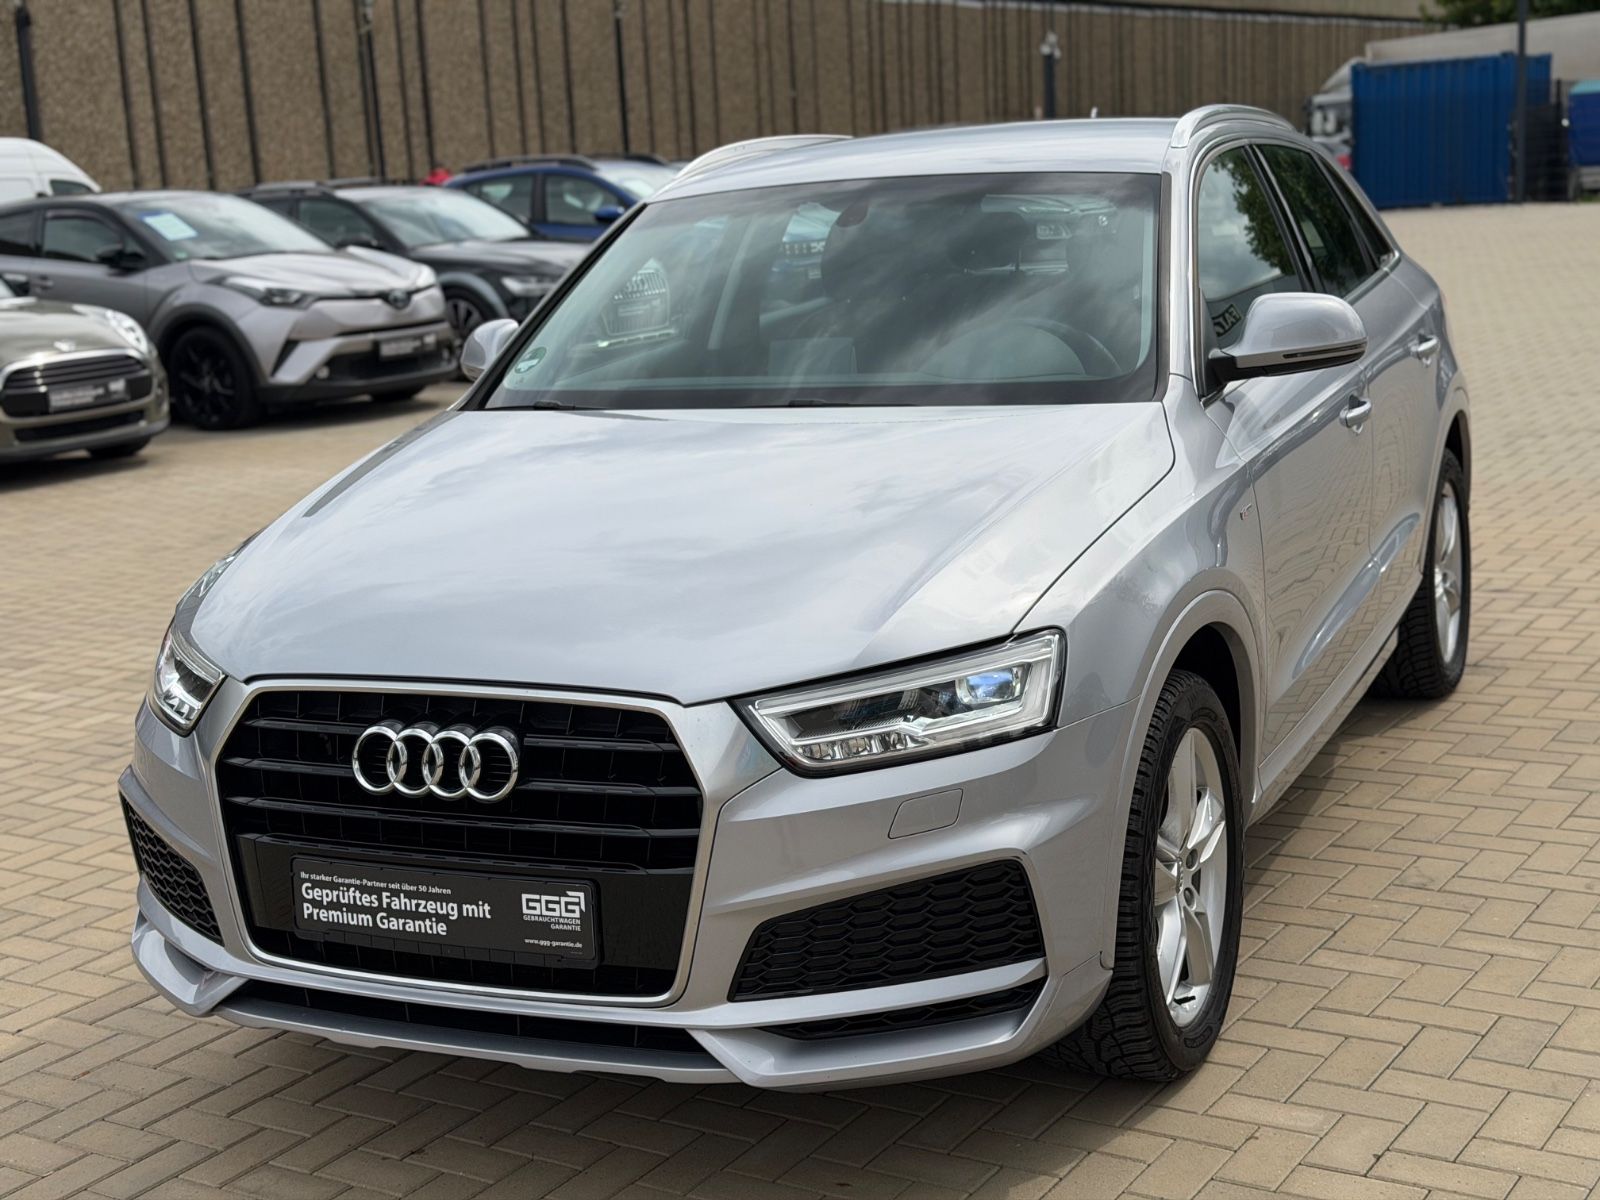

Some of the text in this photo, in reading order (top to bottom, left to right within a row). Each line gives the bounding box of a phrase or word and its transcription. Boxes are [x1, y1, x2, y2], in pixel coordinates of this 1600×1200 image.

[300, 871, 452, 895] Ihr starker Garantie-Partner seit über 50 Jahren
[301, 882, 492, 920] Geprüftes Fahrzeug mit
[521, 892, 581, 919] GGG
[302, 901, 448, 936] Premium Garantie
[522, 914, 581, 925] GEBRAUCHTWAGEN
[550, 923, 582, 932] GARANTIE
[524, 938, 583, 948] www.ggg-garantie.de
